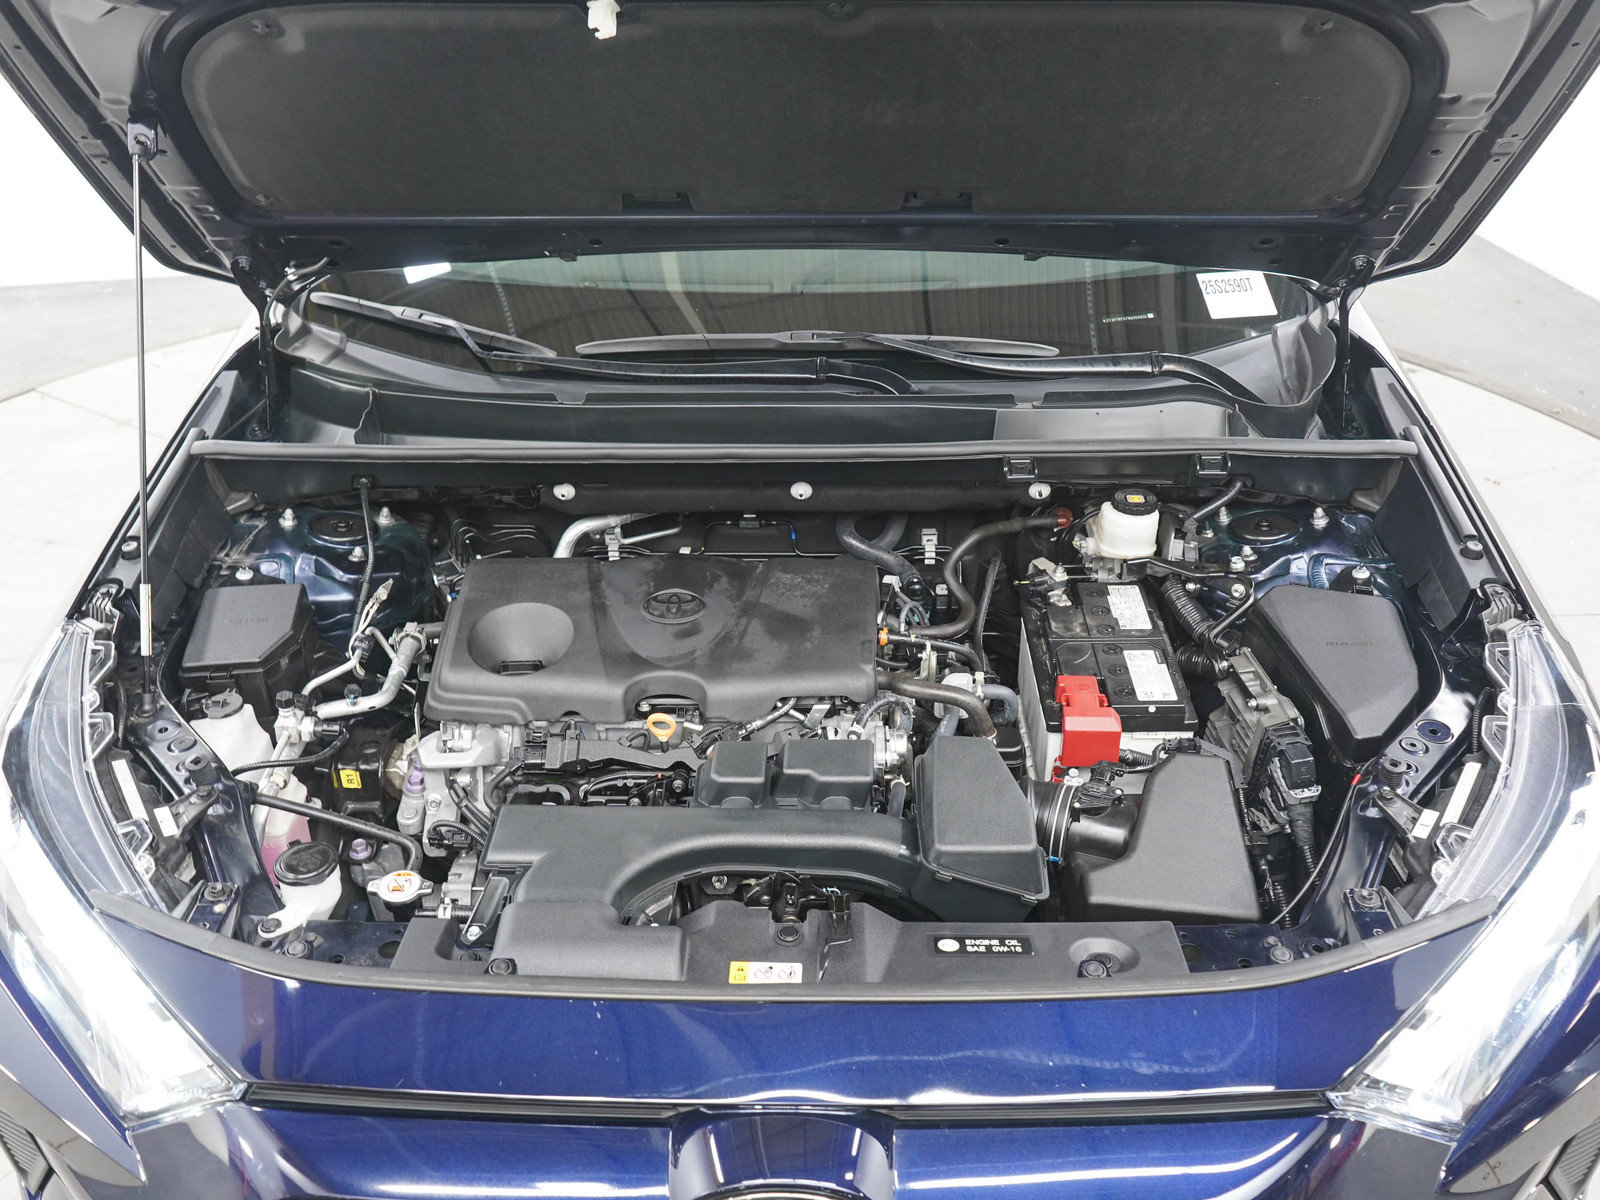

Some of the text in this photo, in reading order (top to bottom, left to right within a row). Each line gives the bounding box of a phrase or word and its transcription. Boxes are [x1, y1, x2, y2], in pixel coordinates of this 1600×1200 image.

[1201, 277, 1253, 295] 25S2590T
[966, 945, 986, 953] SAE
[992, 945, 1023, 953] 0W-16
